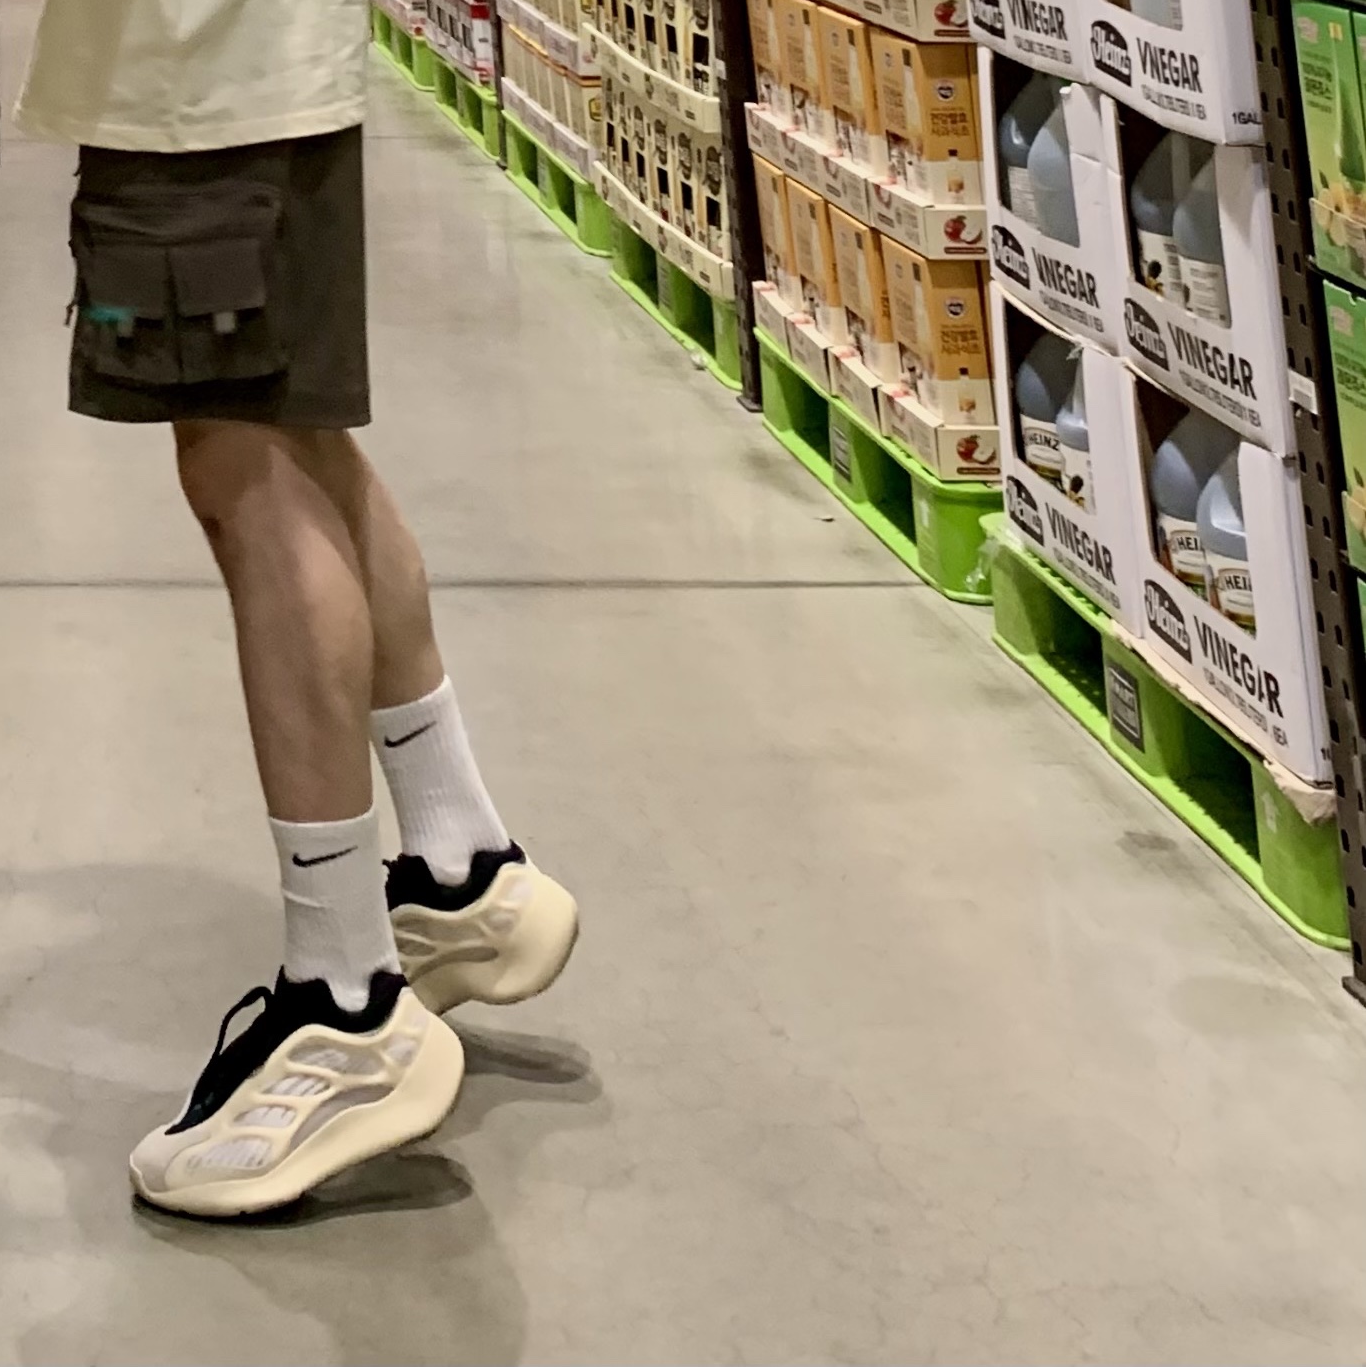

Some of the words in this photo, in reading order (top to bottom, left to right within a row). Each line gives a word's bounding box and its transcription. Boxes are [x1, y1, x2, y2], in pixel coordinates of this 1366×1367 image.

[1091, 25, 1131, 75] Heinz
[1032, 247, 1100, 308] VINEGAR
[1168, 322, 1257, 400] VINEGAR
[1045, 503, 1116, 585] VINEGAR
[1144, 587, 1190, 649] Heinz
[1193, 615, 1283, 718] VINEGAR
